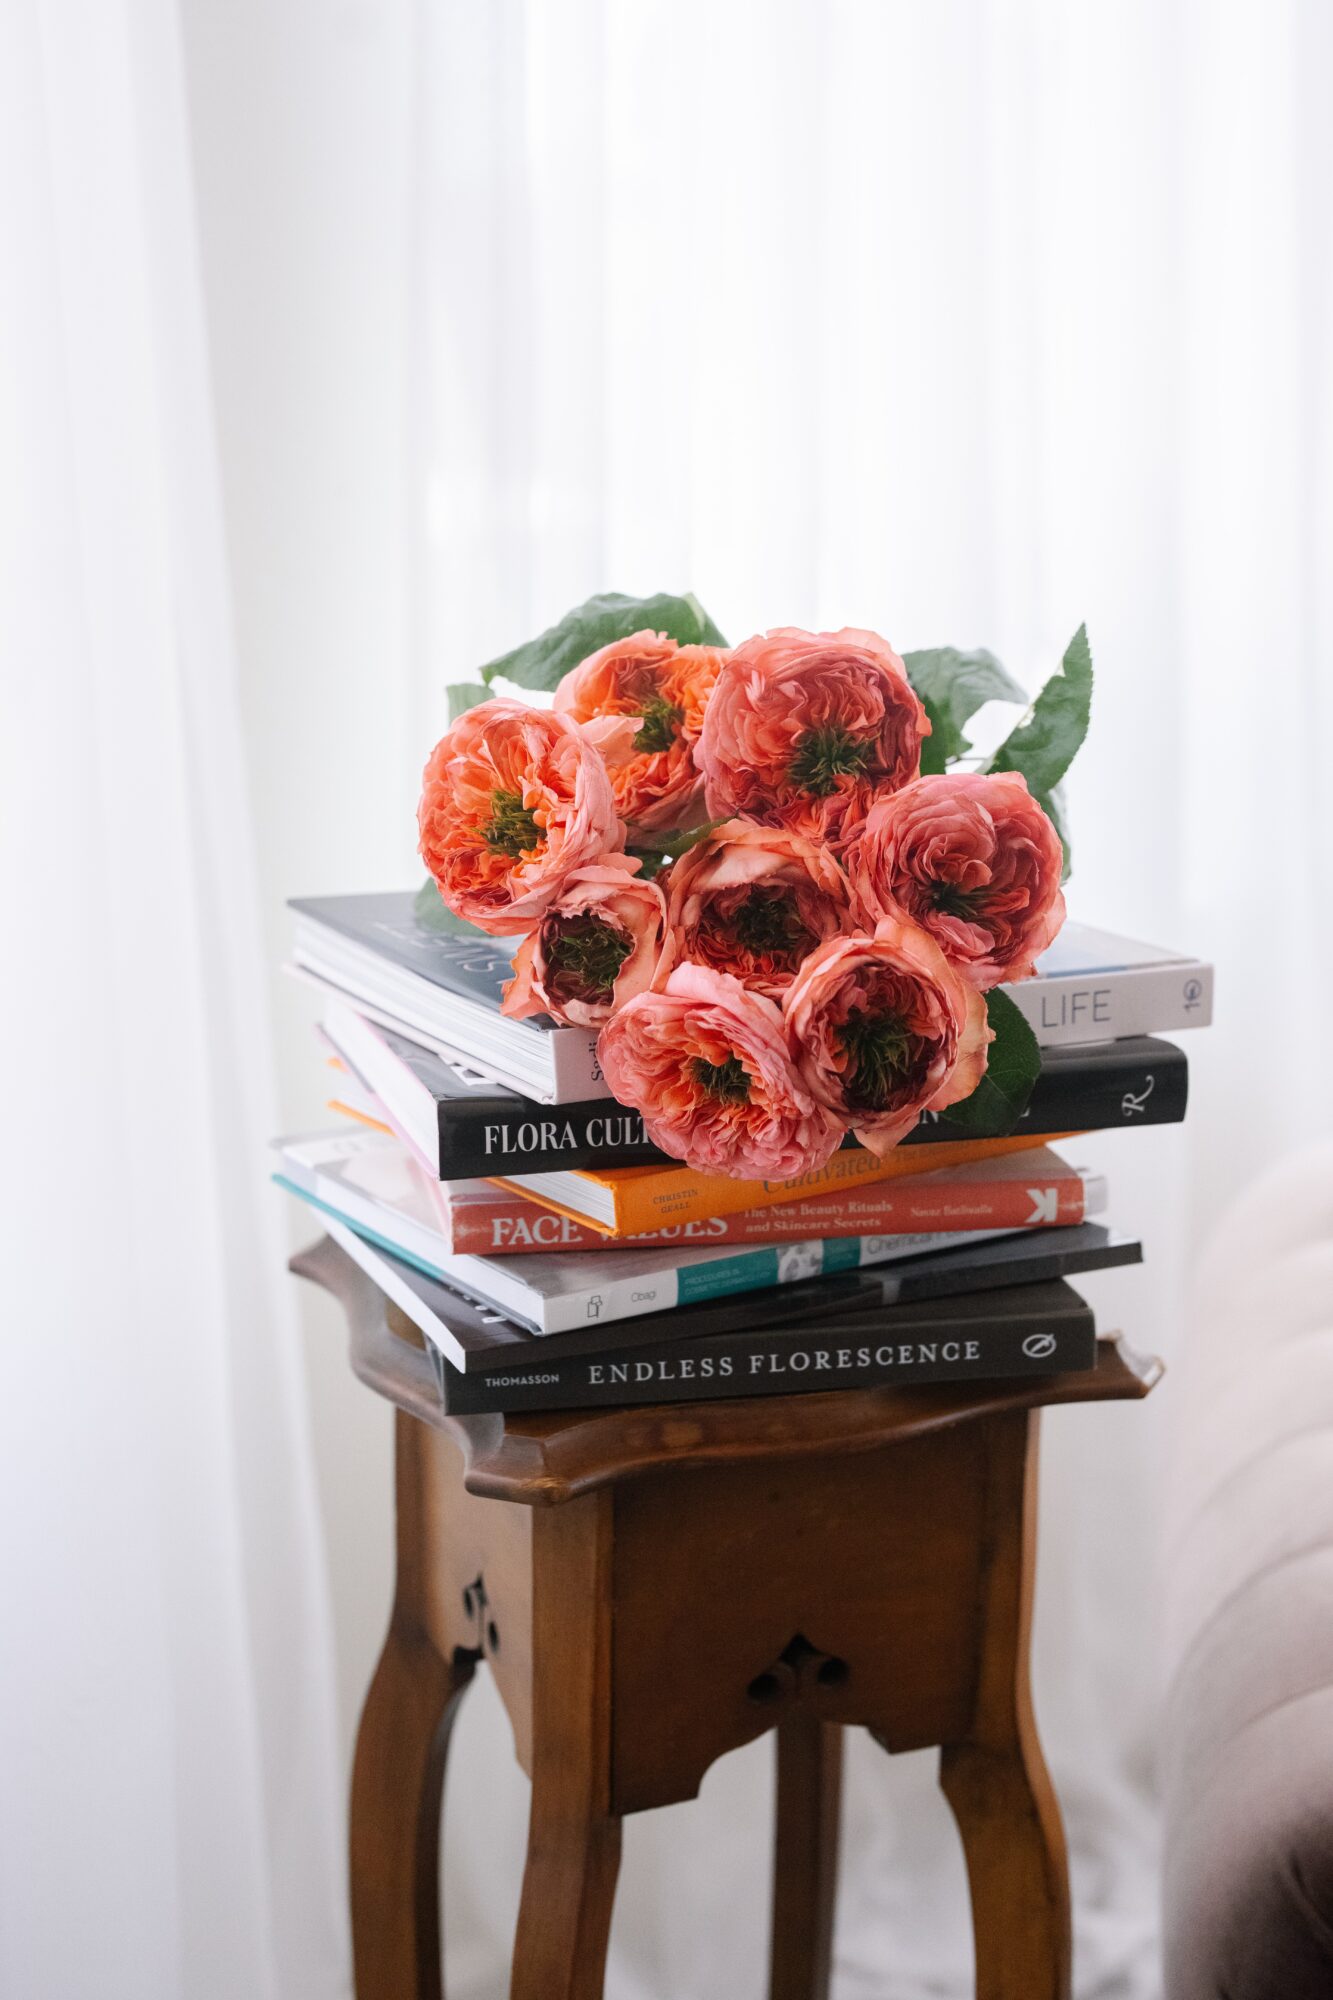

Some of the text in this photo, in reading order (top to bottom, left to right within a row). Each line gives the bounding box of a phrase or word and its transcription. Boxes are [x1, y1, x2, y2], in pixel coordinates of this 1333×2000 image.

[1041, 989, 1111, 1028] LIFE
[484, 1121, 578, 1155] FLORA
[652, 1188, 698, 1205] CHRISTIN
[660, 1202, 690, 1214] GEALL
[770, 1205, 797, 1217] New
[800, 1203, 845, 1217] Beauty
[847, 1200, 893, 1213] Rituals
[491, 1215, 583, 1247] FACE
[745, 1217, 882, 1233] and Skincare Secrets
[485, 1341, 981, 1388] THOMASSON ENDLESS FLORESCENCE
